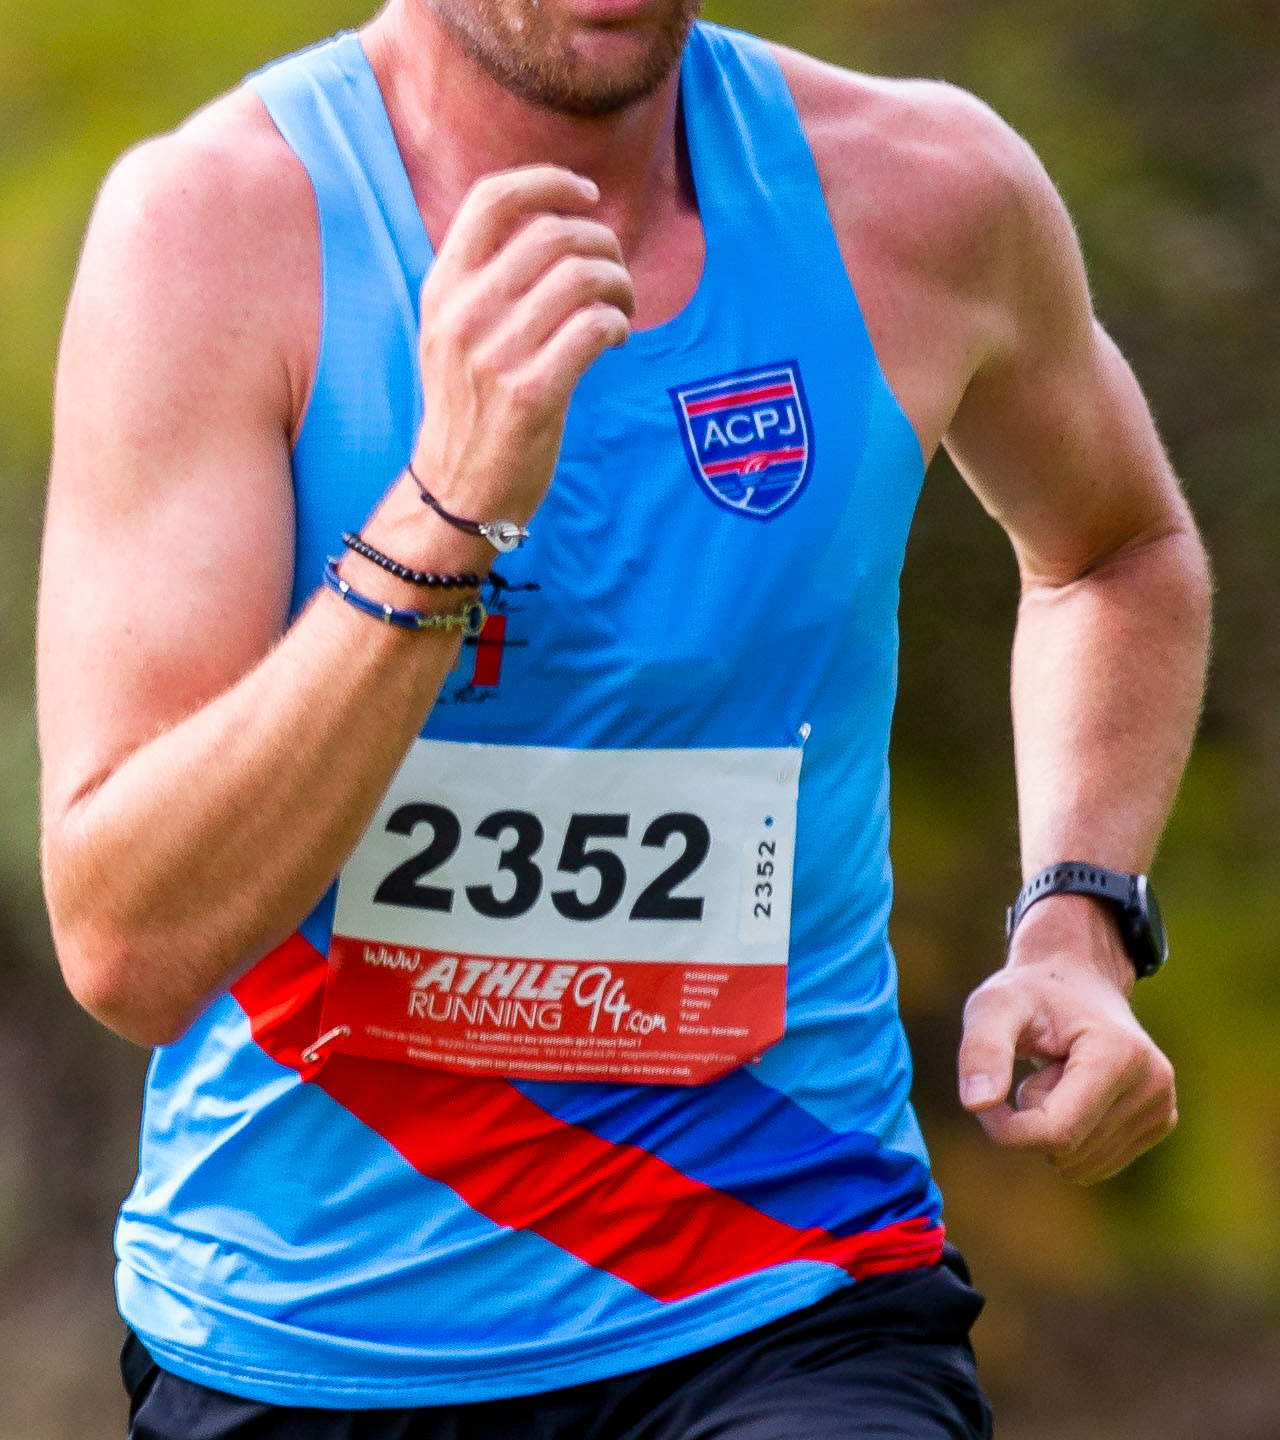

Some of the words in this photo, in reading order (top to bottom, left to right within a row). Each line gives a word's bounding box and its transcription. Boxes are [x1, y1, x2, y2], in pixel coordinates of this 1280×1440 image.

[703, 405, 797, 451] ACPJ
[372, 801, 712, 922] 2352
[753, 840, 777, 920] 2352
[407, 990, 562, 1031] RUNNING
